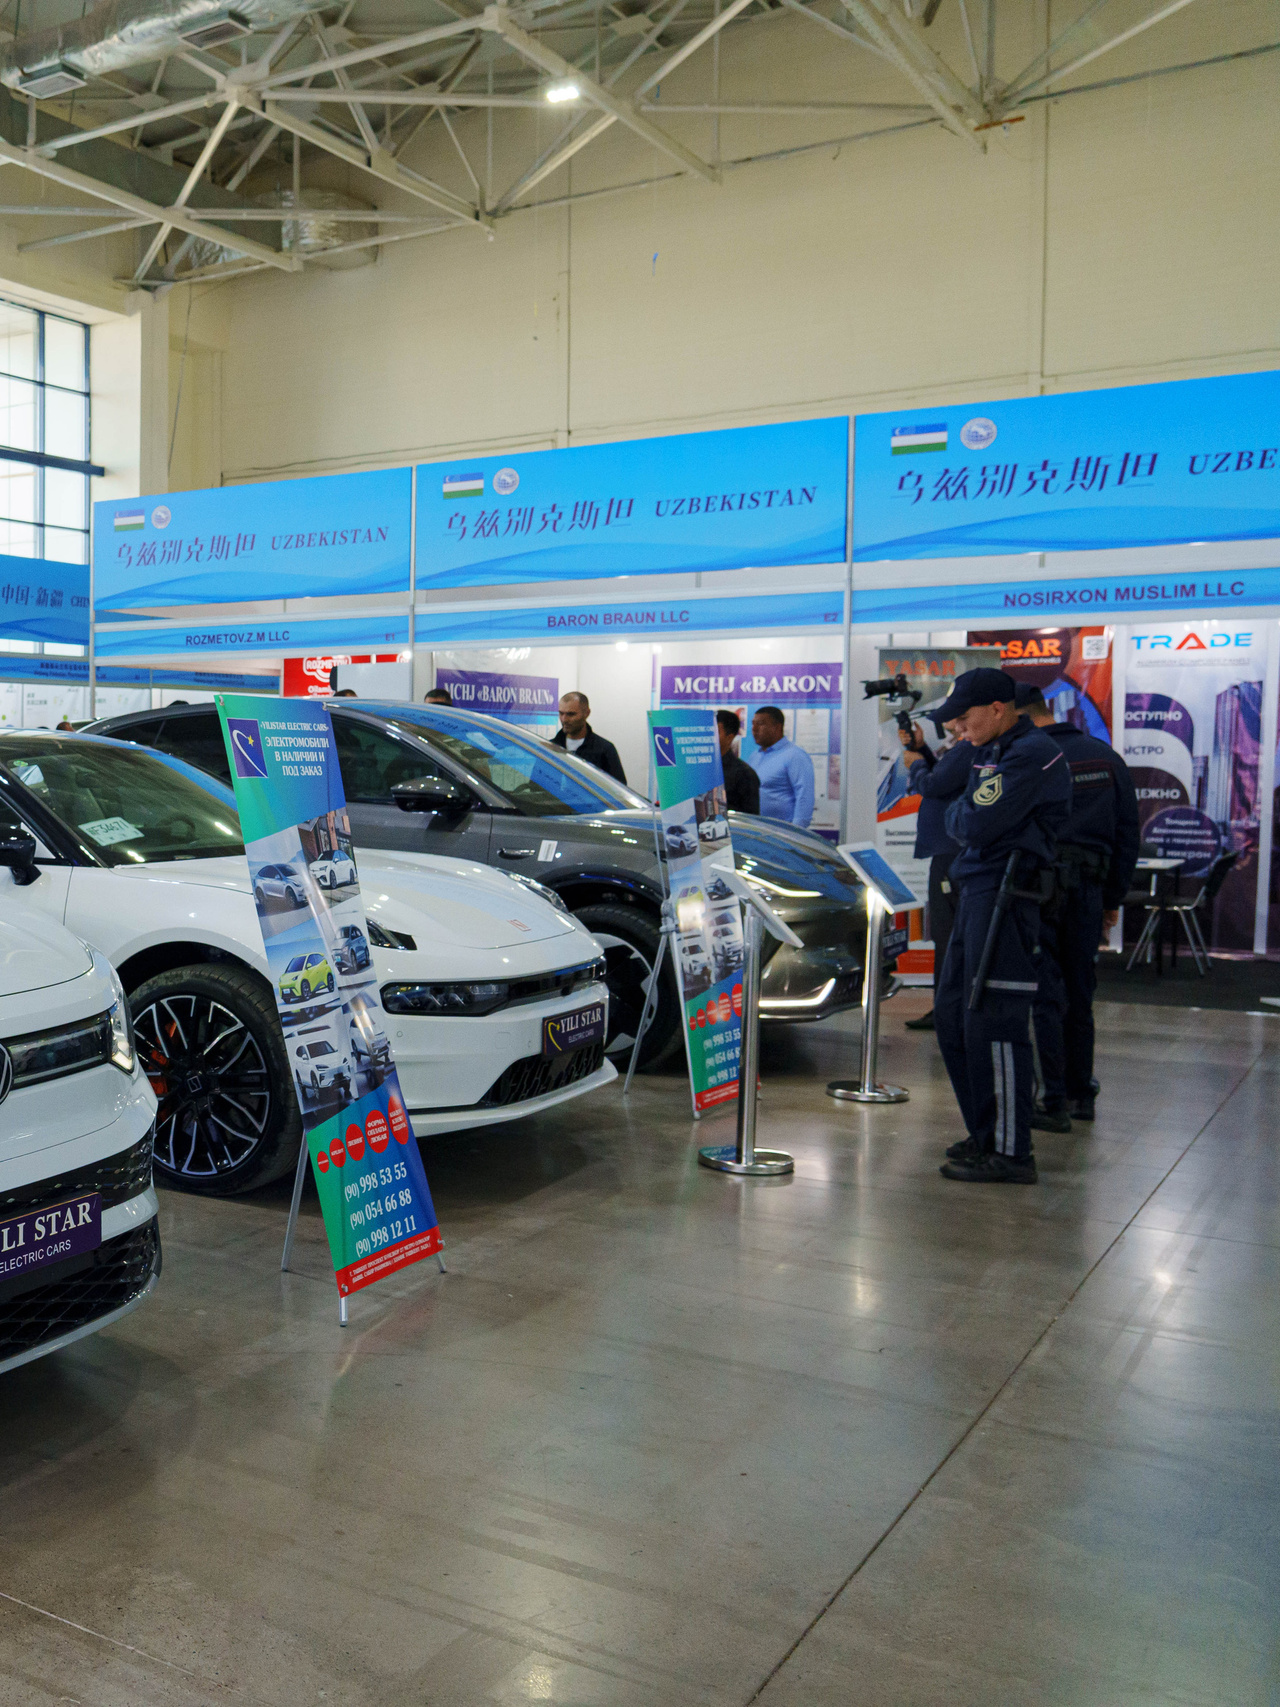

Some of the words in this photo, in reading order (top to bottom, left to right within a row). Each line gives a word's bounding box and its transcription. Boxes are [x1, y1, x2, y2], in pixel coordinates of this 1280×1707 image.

[1188, 447, 1280, 475] UZBE
[891, 452, 1159, 505] 乌兹别克斯坦
[655, 486, 818, 518] UZBEKISTAN
[443, 498, 634, 542] 乌兹别克斯坦
[270, 526, 391, 551] UZBEKISTAN
[1004, 587, 1108, 607] NOSIRXON
[1114, 583, 1197, 602] MUSLIM
[1204, 580, 1245, 597] LLC
[547, 613, 599, 628] BARON
[603, 611, 656, 626] BRAUN
[660, 610, 690, 624] LLC
[269, 631, 290, 642] LLC
[1130, 632, 1253, 651] TRADE
[885, 660, 956, 676] YASAR
[444, 682, 475, 701] MCHJ
[674, 676, 736, 694] MCHJ
[740, 675, 832, 693] «BARON
[1124, 710, 1183, 721] ОСТУПНО
[287, 722, 313, 731] ELECTRIC
[265, 736, 330, 748] ЭЛЕКТРОМОБИЛИ
[275, 751, 281, 761] В
[282, 751, 318, 762] НАЛИЧИИ
[319, 751, 325, 762] И
[282, 765, 300, 776] ПОД
[300, 765, 323, 776] ЗАКАЗ
[561, 1015, 580, 1033] YILI
[581, 1008, 602, 1027] STAR
[344, 1183, 360, 1203] (90)
[359, 1175, 379, 1194] 998
[380, 1166, 393, 1186] 53
[394, 1161, 407, 1180] 55
[349, 1211, 365, 1230] (90)
[365, 1200, 383, 1221] 054
[385, 1193, 397, 1212] 66
[398, 1188, 412, 1208] 88
[34, 1201, 93, 1242] STAR
[355, 1238, 371, 1258] (90)
[370, 1228, 389, 1249] 998
[390, 1220, 403, 1240] 12
[404, 1215, 417, 1233] 11
[46, 1239, 72, 1257] CARS
